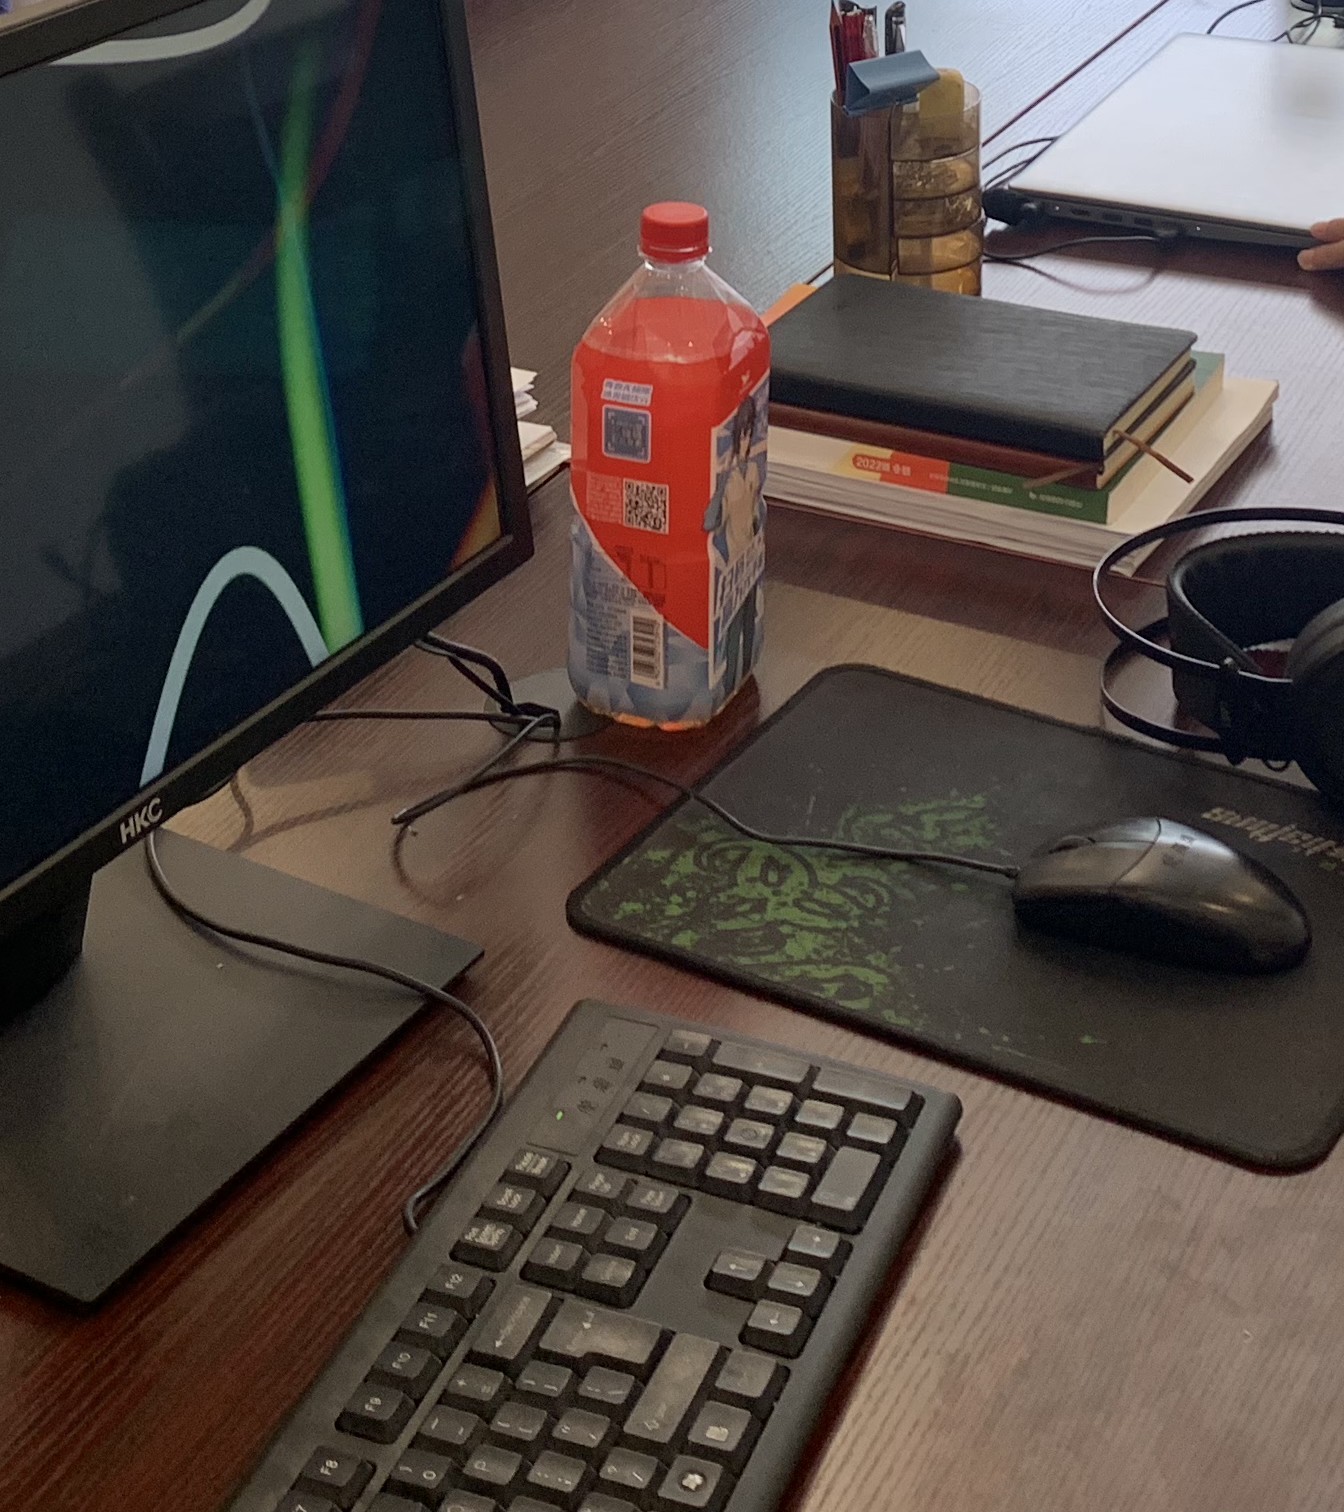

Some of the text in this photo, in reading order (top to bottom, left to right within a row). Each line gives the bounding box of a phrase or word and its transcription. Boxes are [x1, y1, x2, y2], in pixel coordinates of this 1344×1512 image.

[120, 798, 162, 844] HKC
[445, 1273, 464, 1290] F12
[419, 1312, 438, 1329] F11
[320, 1459, 338, 1476] F8
